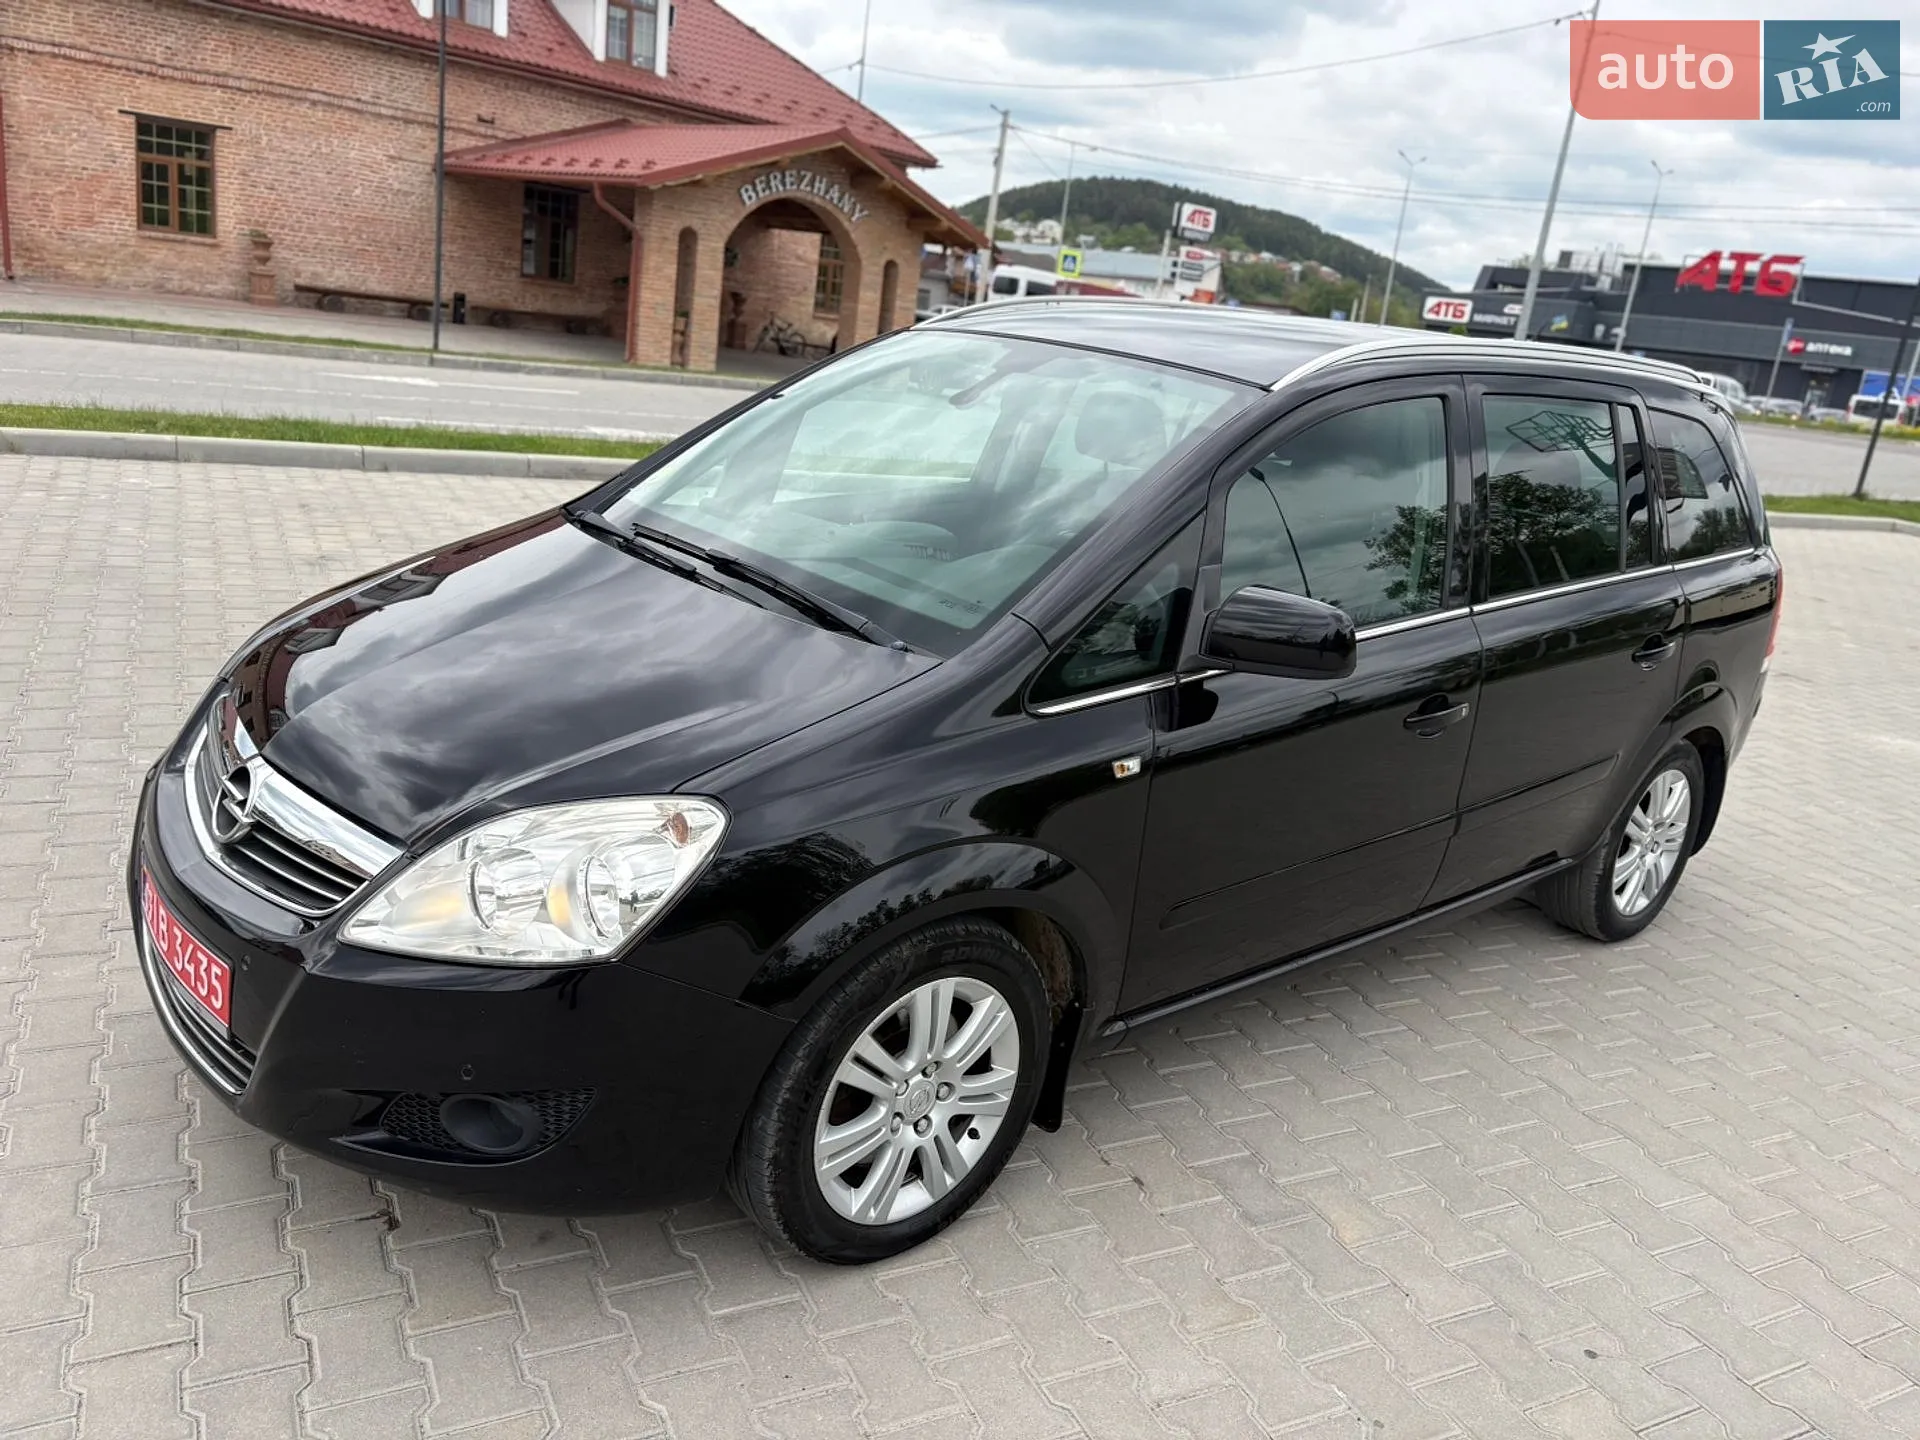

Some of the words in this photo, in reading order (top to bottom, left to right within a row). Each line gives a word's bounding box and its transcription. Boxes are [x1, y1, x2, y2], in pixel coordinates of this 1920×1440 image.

[740, 169, 869, 222] BEREZHANY
[1676, 251, 1804, 297] АТБ
[1428, 301, 1467, 319] АТБ
[173, 927, 223, 1010] 3435
